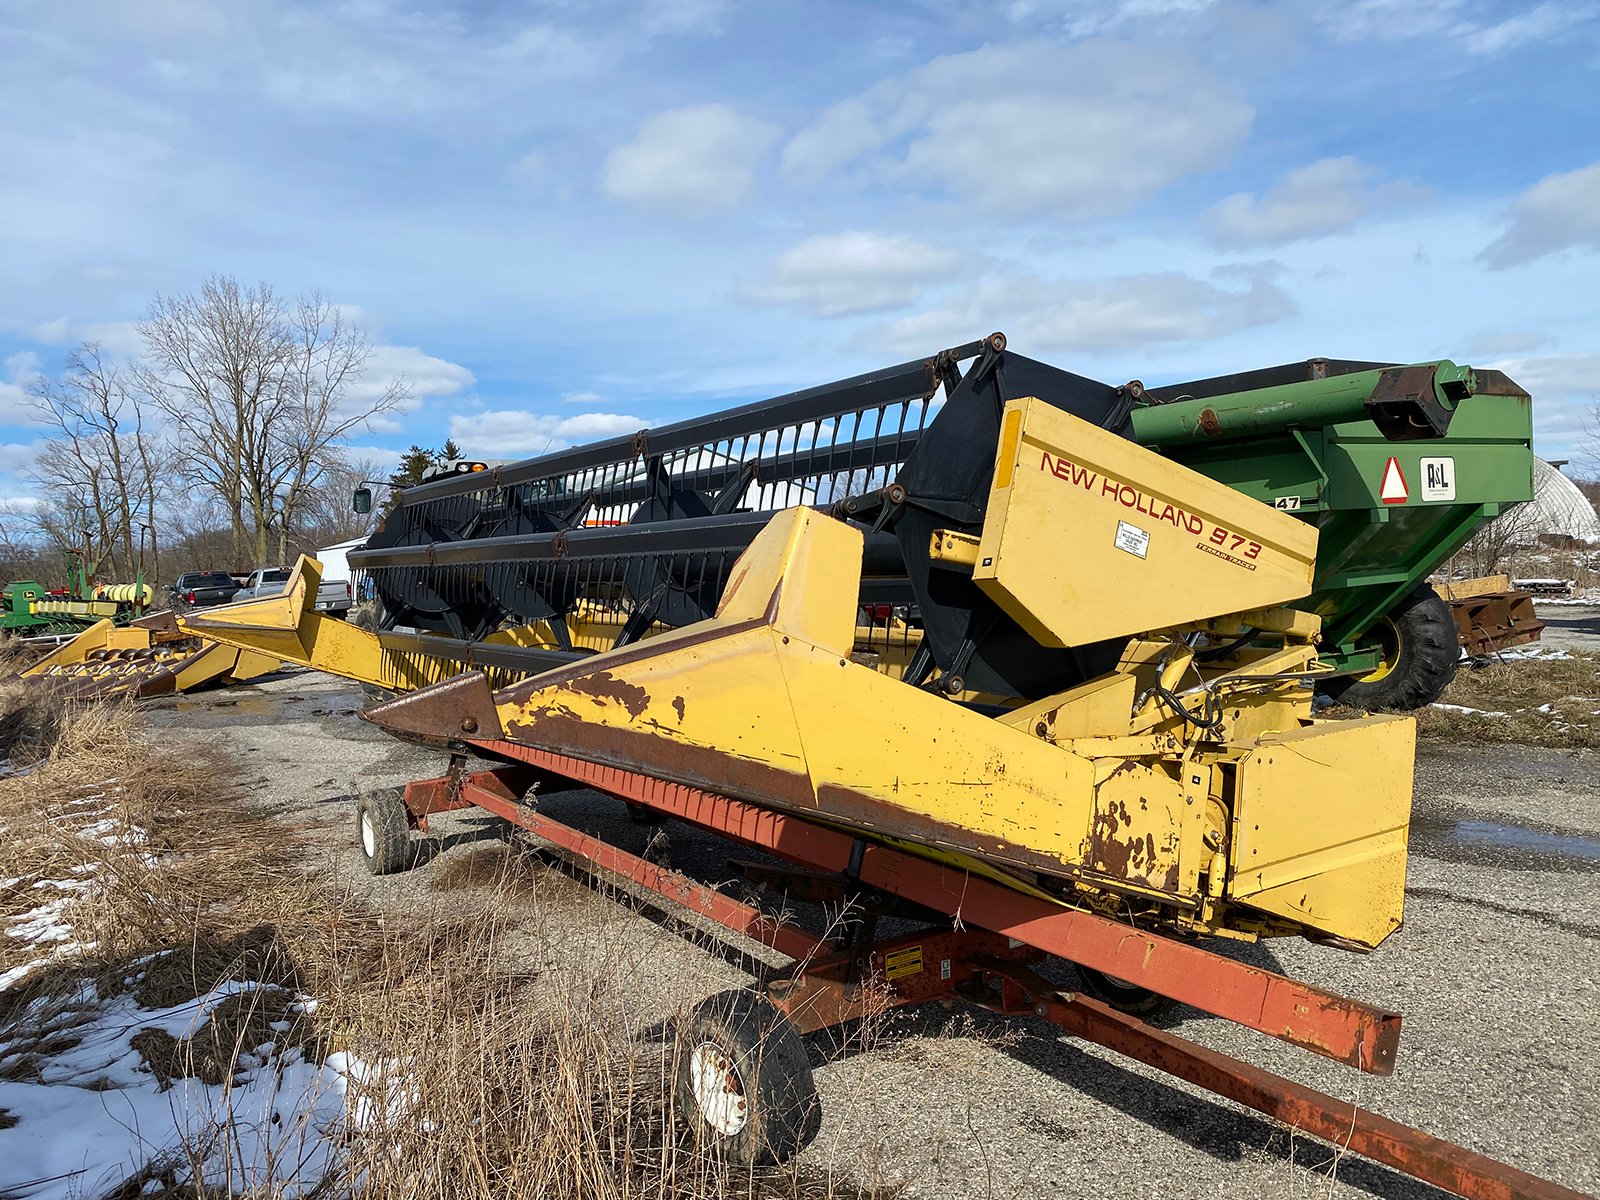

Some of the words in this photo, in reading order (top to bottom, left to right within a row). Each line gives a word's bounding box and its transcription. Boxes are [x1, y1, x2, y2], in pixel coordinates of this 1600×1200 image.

[1427, 463, 1449, 488] A&L
[1041, 452, 1097, 491] NEW
[1101, 478, 1203, 535] HOLLAND
[1209, 527, 1262, 560] 973
[1276, 497, 1299, 509] 47
[1197, 543, 1228, 560] TERRAIN
[1228, 556, 1256, 571] TRACER
